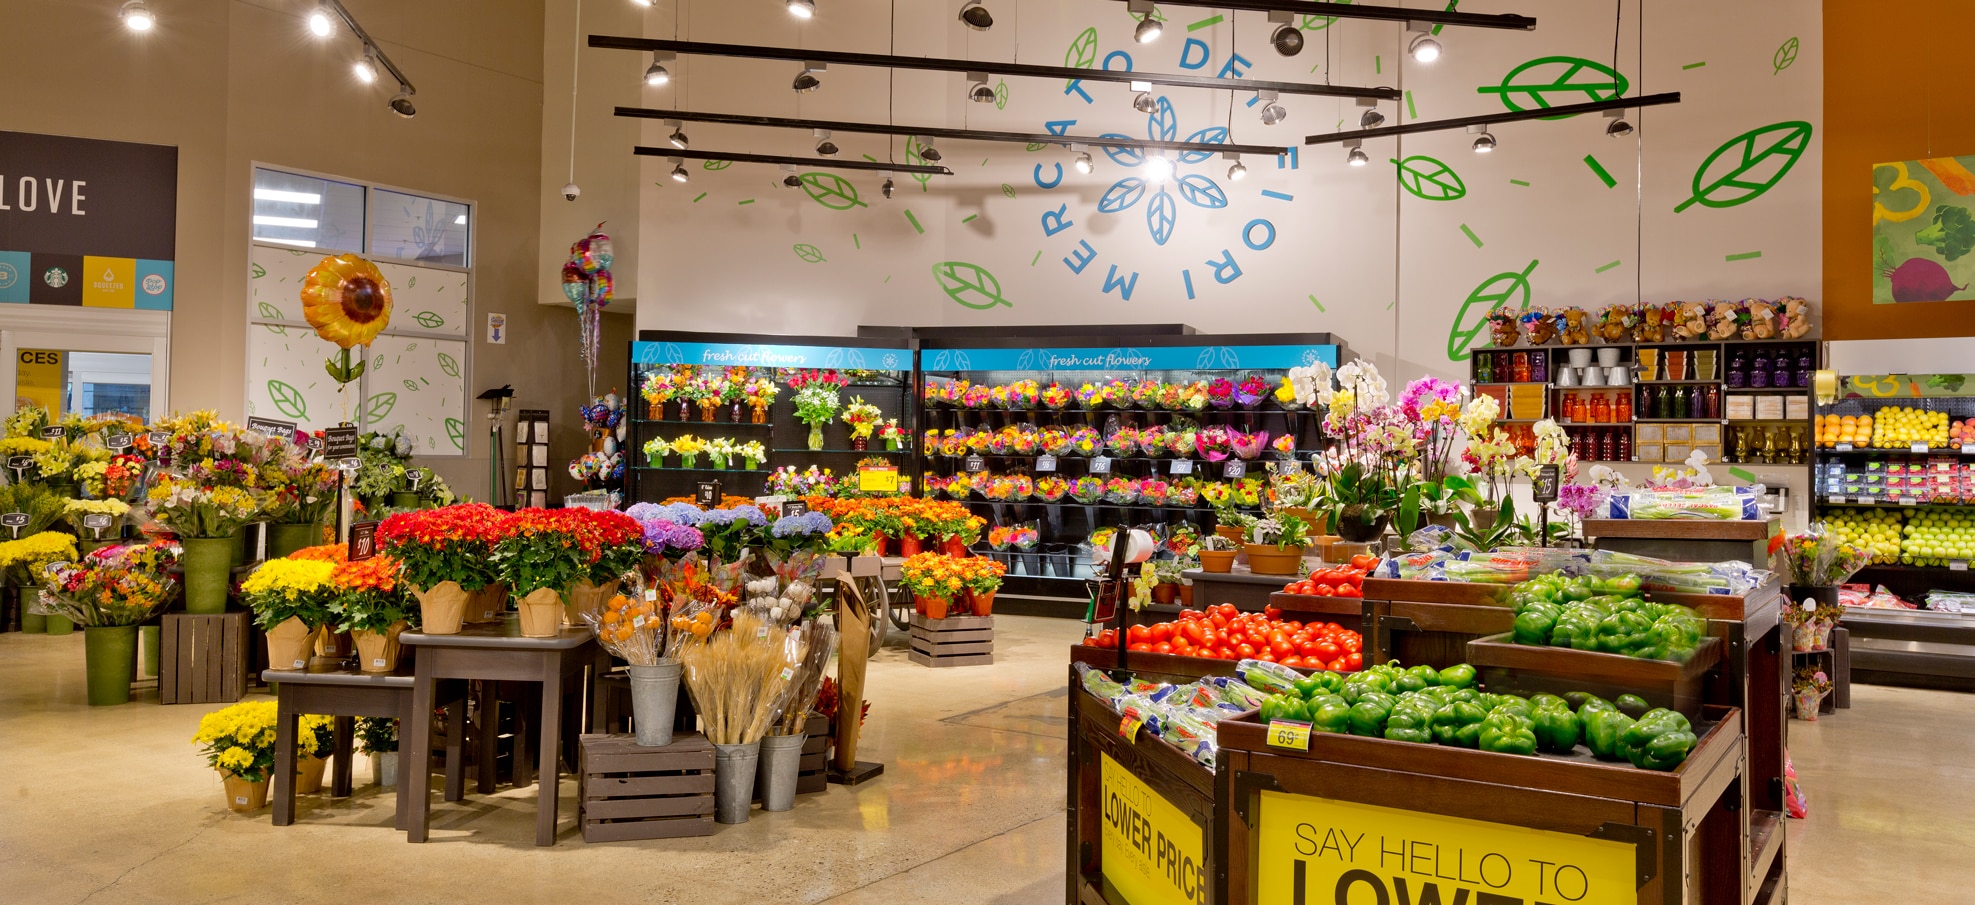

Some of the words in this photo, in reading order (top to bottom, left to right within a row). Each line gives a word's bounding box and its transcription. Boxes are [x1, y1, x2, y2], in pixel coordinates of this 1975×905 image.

[0, 175, 86, 215] LOVE
[20, 351, 59, 364] CES
[703, 349, 734, 362] fresh
[737, 353, 760, 362] cut
[762, 351, 807, 364] flowers
[1050, 354, 1081, 368] fresh
[1083, 356, 1105, 366] cut
[1106, 354, 1152, 367] flowers
[120, 436, 128, 445] $5
[1094, 462, 1106, 471] $16
[1228, 466, 1241, 476] $20
[16, 516, 26, 524] $5
[357, 536, 370, 556] $10
[1104, 762, 1116, 787] SAY
[1116, 772, 1140, 806] HELLO
[1141, 790, 1152, 817] TO
[1105, 784, 1151, 860] LOWER
[1294, 822, 1365, 863] SAY
[1381, 836, 1512, 888] HELLO
[1528, 859, 1588, 902] TO
